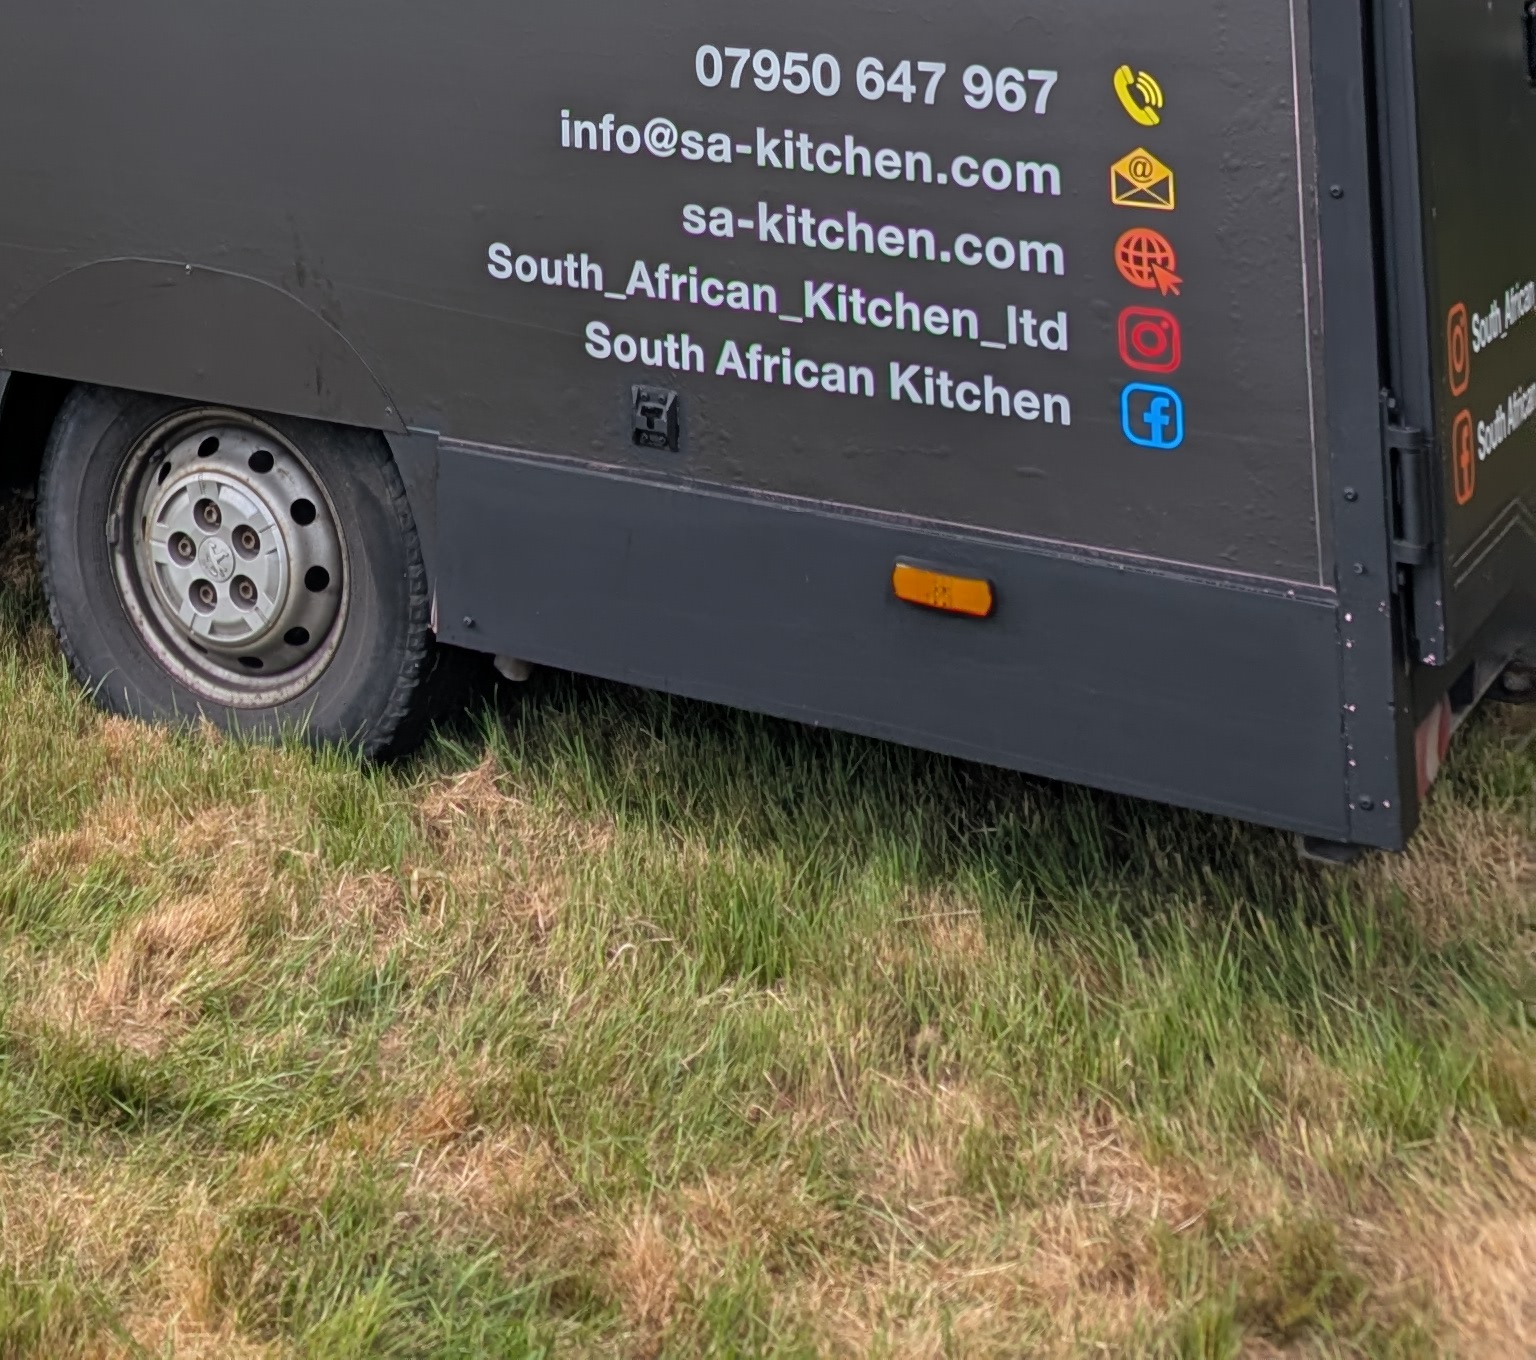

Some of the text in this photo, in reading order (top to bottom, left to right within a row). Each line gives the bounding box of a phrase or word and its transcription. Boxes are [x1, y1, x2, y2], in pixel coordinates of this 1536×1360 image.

[695, 44, 1059, 115] 07950 647 967
[560, 109, 1063, 196] info@sa-kitchen.com
[681, 201, 1065, 275] sa-kitchen.com
[487, 241, 1070, 352] South_African_Kitchen_ltd
[1472, 280, 1536, 353] South_African
[584, 321, 1072, 426] South African Kitchen
[1477, 404, 1507, 462] South
